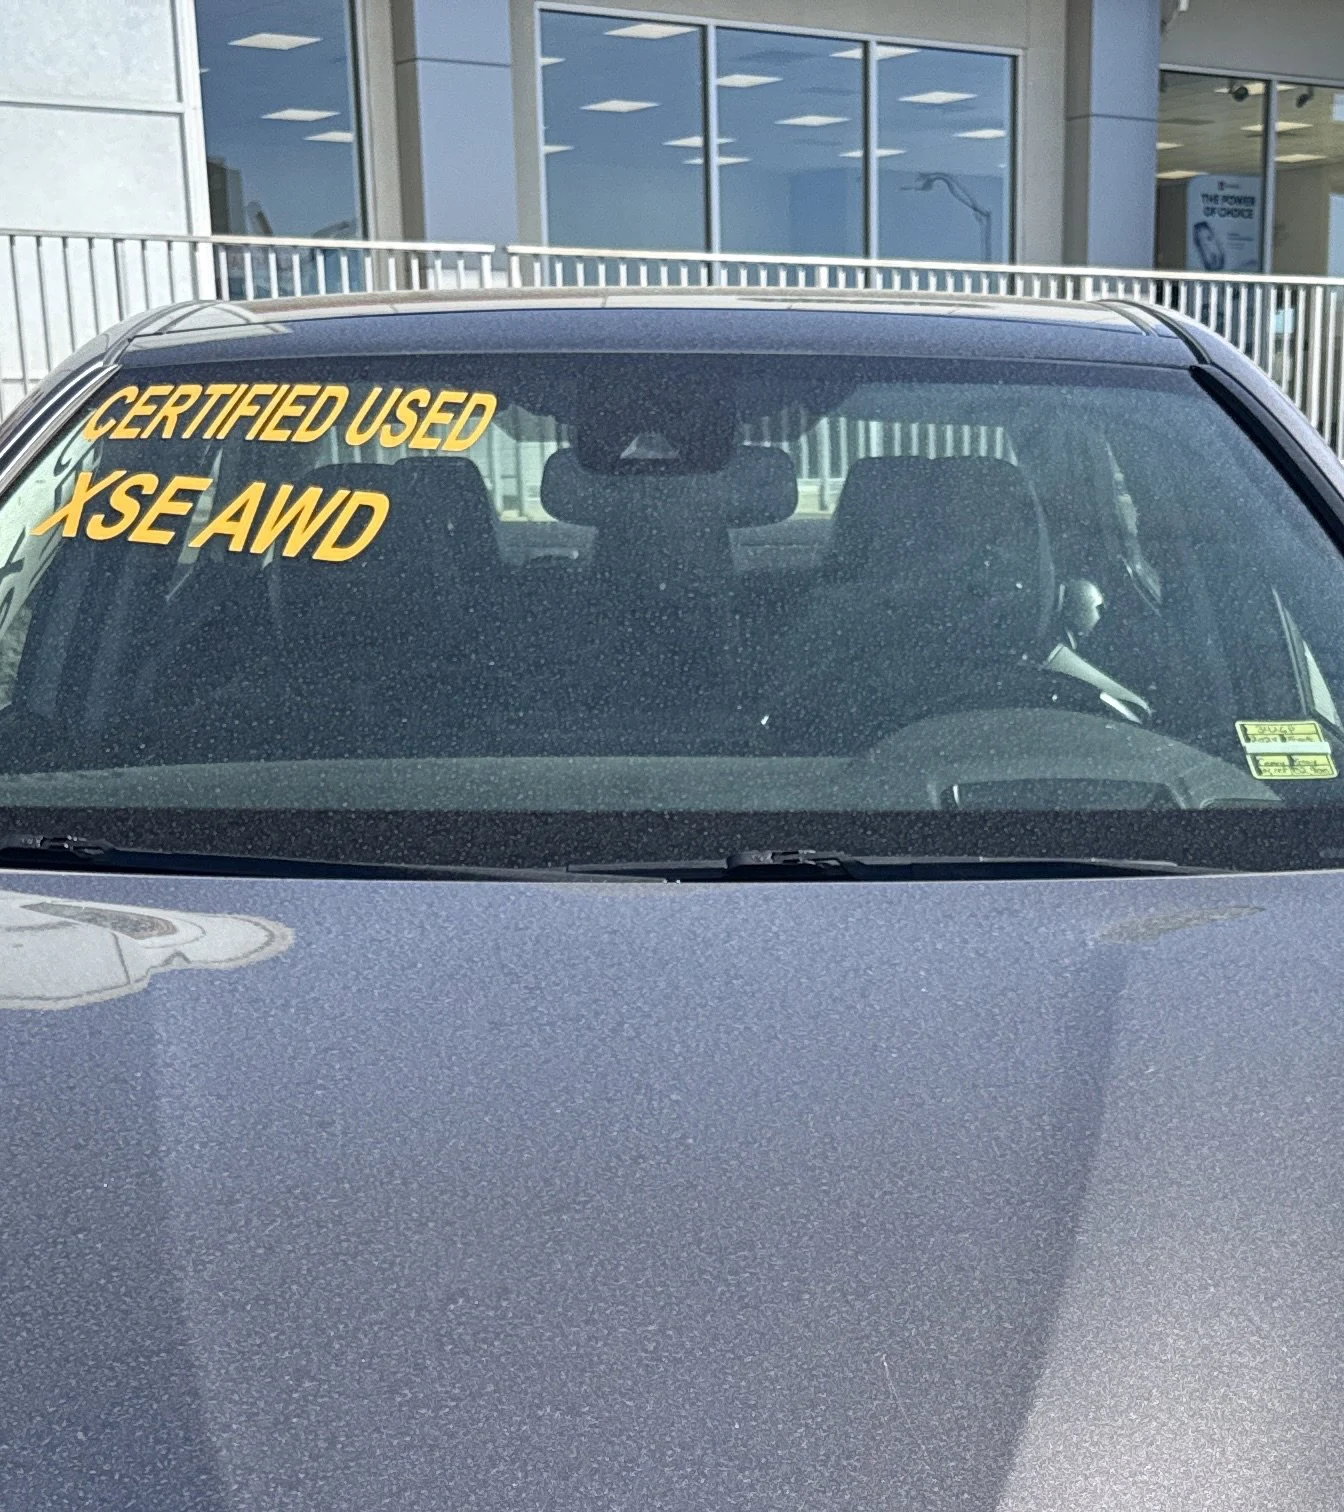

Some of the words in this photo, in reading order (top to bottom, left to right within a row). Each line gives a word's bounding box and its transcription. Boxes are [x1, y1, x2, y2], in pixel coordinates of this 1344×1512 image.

[1201, 193, 1218, 205] THE
[1222, 195, 1255, 206] POWER
[83, 383, 348, 442] CERTIFIED
[346, 387, 497, 451] USED
[30, 470, 212, 546] XSE
[188, 481, 390, 562] AWD
